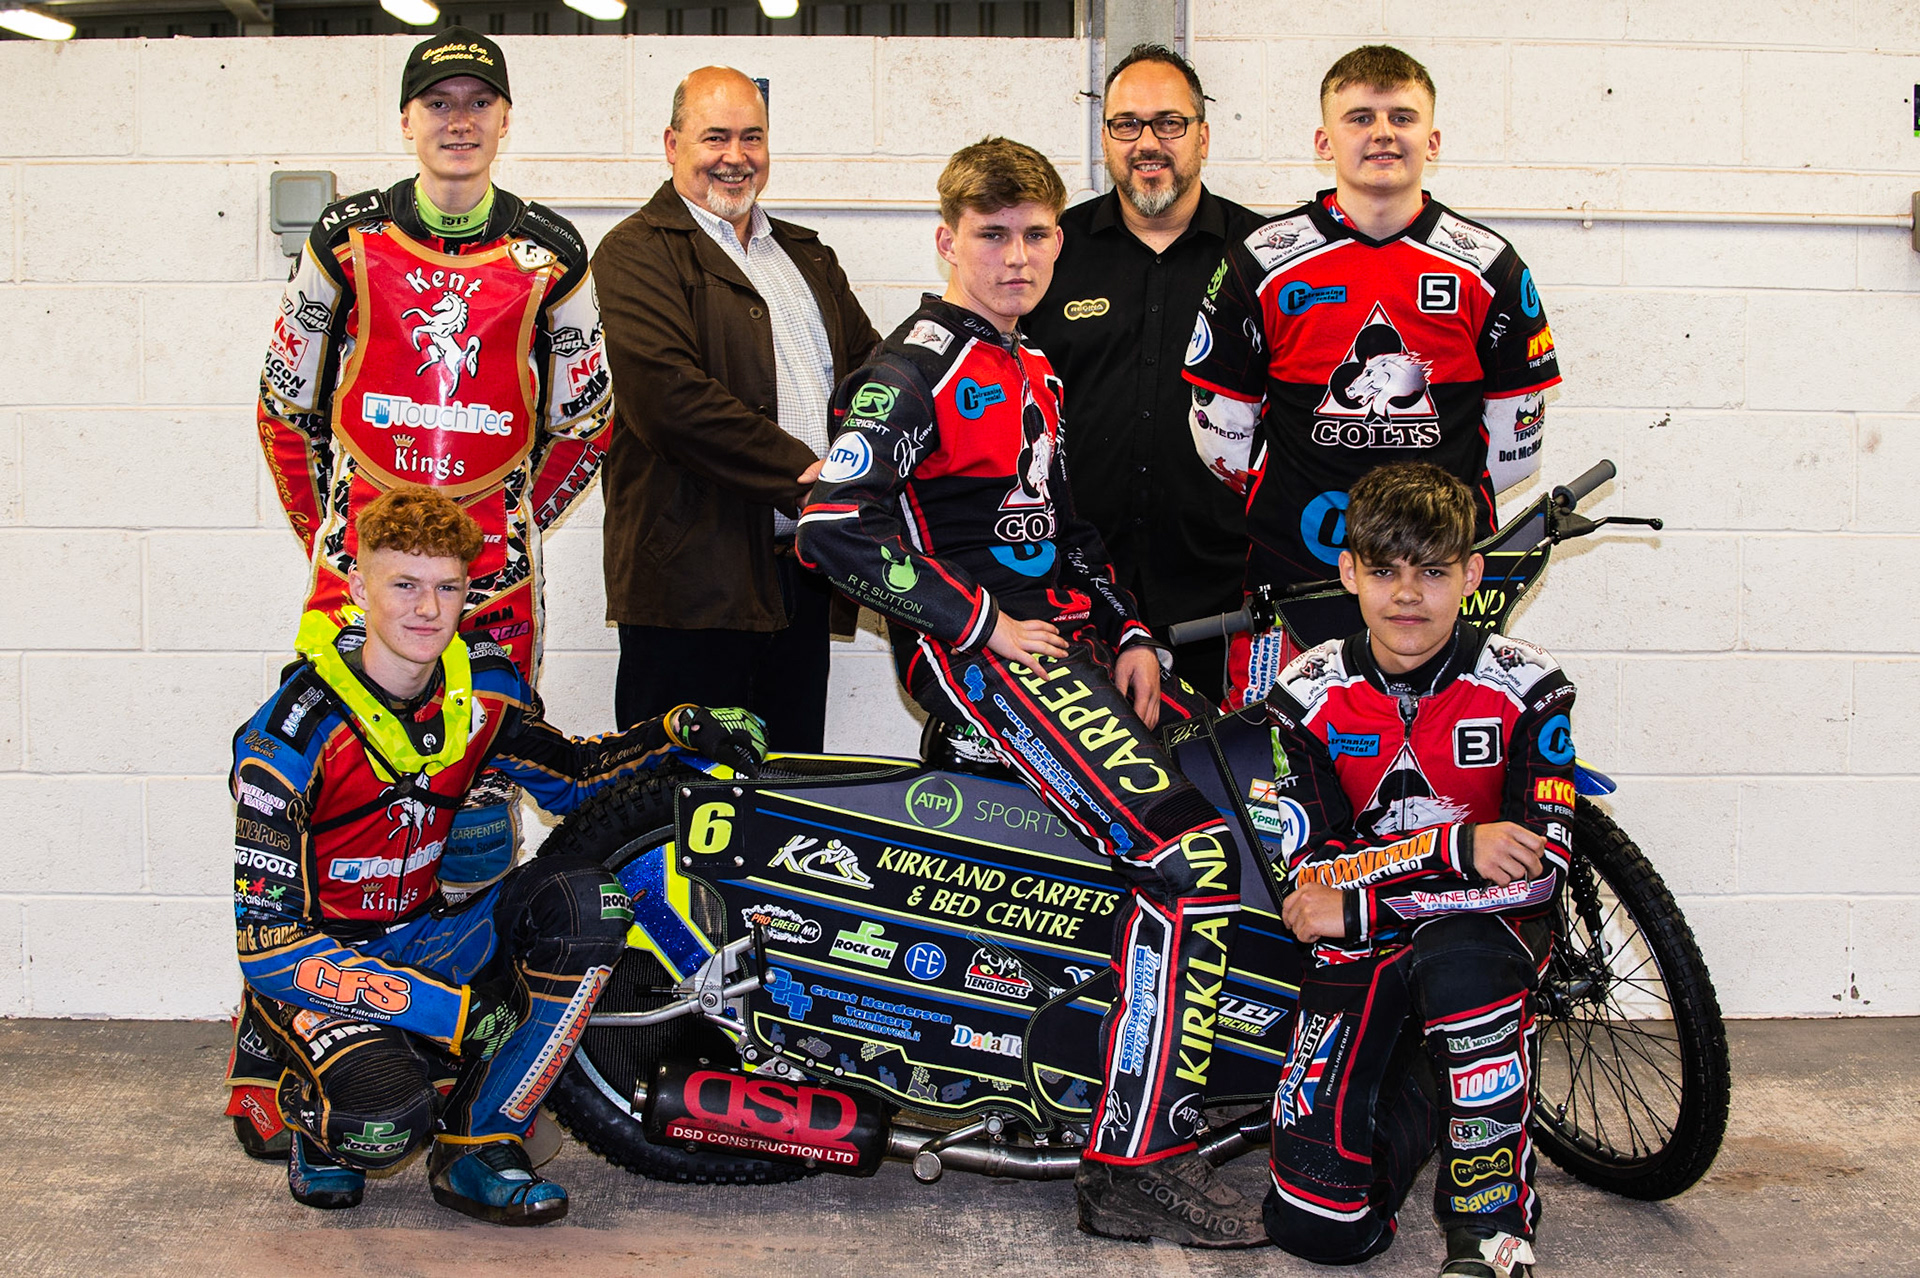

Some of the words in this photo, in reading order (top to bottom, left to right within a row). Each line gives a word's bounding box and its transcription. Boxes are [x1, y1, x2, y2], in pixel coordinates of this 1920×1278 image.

[405, 267, 483, 298] Kent
[1426, 279, 1450, 307] 5
[392, 399, 512, 433] TouchTec
[1312, 420, 1441, 449] COLTS
[394, 448, 464, 480] Kings
[871, 586, 924, 614] SUTTON
[993, 694, 1033, 737] Grant
[1032, 737, 1111, 823] Henderson
[1016, 732, 1074, 795] Tankers
[1465, 730, 1490, 761] 3
[452, 820, 507, 839] CARPENTER
[688, 801, 736, 854] 6
[914, 791, 952, 813] ATPI
[974, 799, 1068, 838] SPORTS
[877, 846, 1006, 893] KIRKLAND
[1011, 876, 1119, 916] CARPETS
[1413, 890, 1464, 903] WAYNE
[1468, 882, 1528, 900] CARTER
[907, 885, 926, 907] &
[929, 888, 981, 918] BED
[986, 901, 1083, 939] CENTRE
[1426, 901, 1474, 910] SPEEDWAY
[1479, 895, 1520, 907] ACADEMY
[801, 924, 819, 938] MX
[834, 938, 870, 957] ROCK
[871, 946, 893, 960] OIL
[1176, 832, 1229, 1085] KIRKLAND
[295, 957, 409, 1013] CFS
[1134, 959, 1144, 1014] PROPERTY
[308, 997, 349, 1013] Complete
[350, 1008, 391, 1021] Filtration
[553, 969, 596, 1040] PLASTERING
[810, 985, 858, 1004] Grant
[861, 995, 953, 1024] Henderson
[845, 1005, 912, 1030] Tankers
[1124, 1015, 1137, 1061] SERVICES
[501, 1043, 555, 1114] CONTRACTORS
[516, 1044, 573, 1114] PARSONS
[1457, 1061, 1517, 1099] 100%
[345, 1137, 383, 1152] ROCK
[672, 1126, 704, 1141] DSD
[707, 1131, 823, 1158] CONSTRUCTION
[826, 1150, 855, 1164] LTD
[1138, 1179, 1240, 1236] daytona
